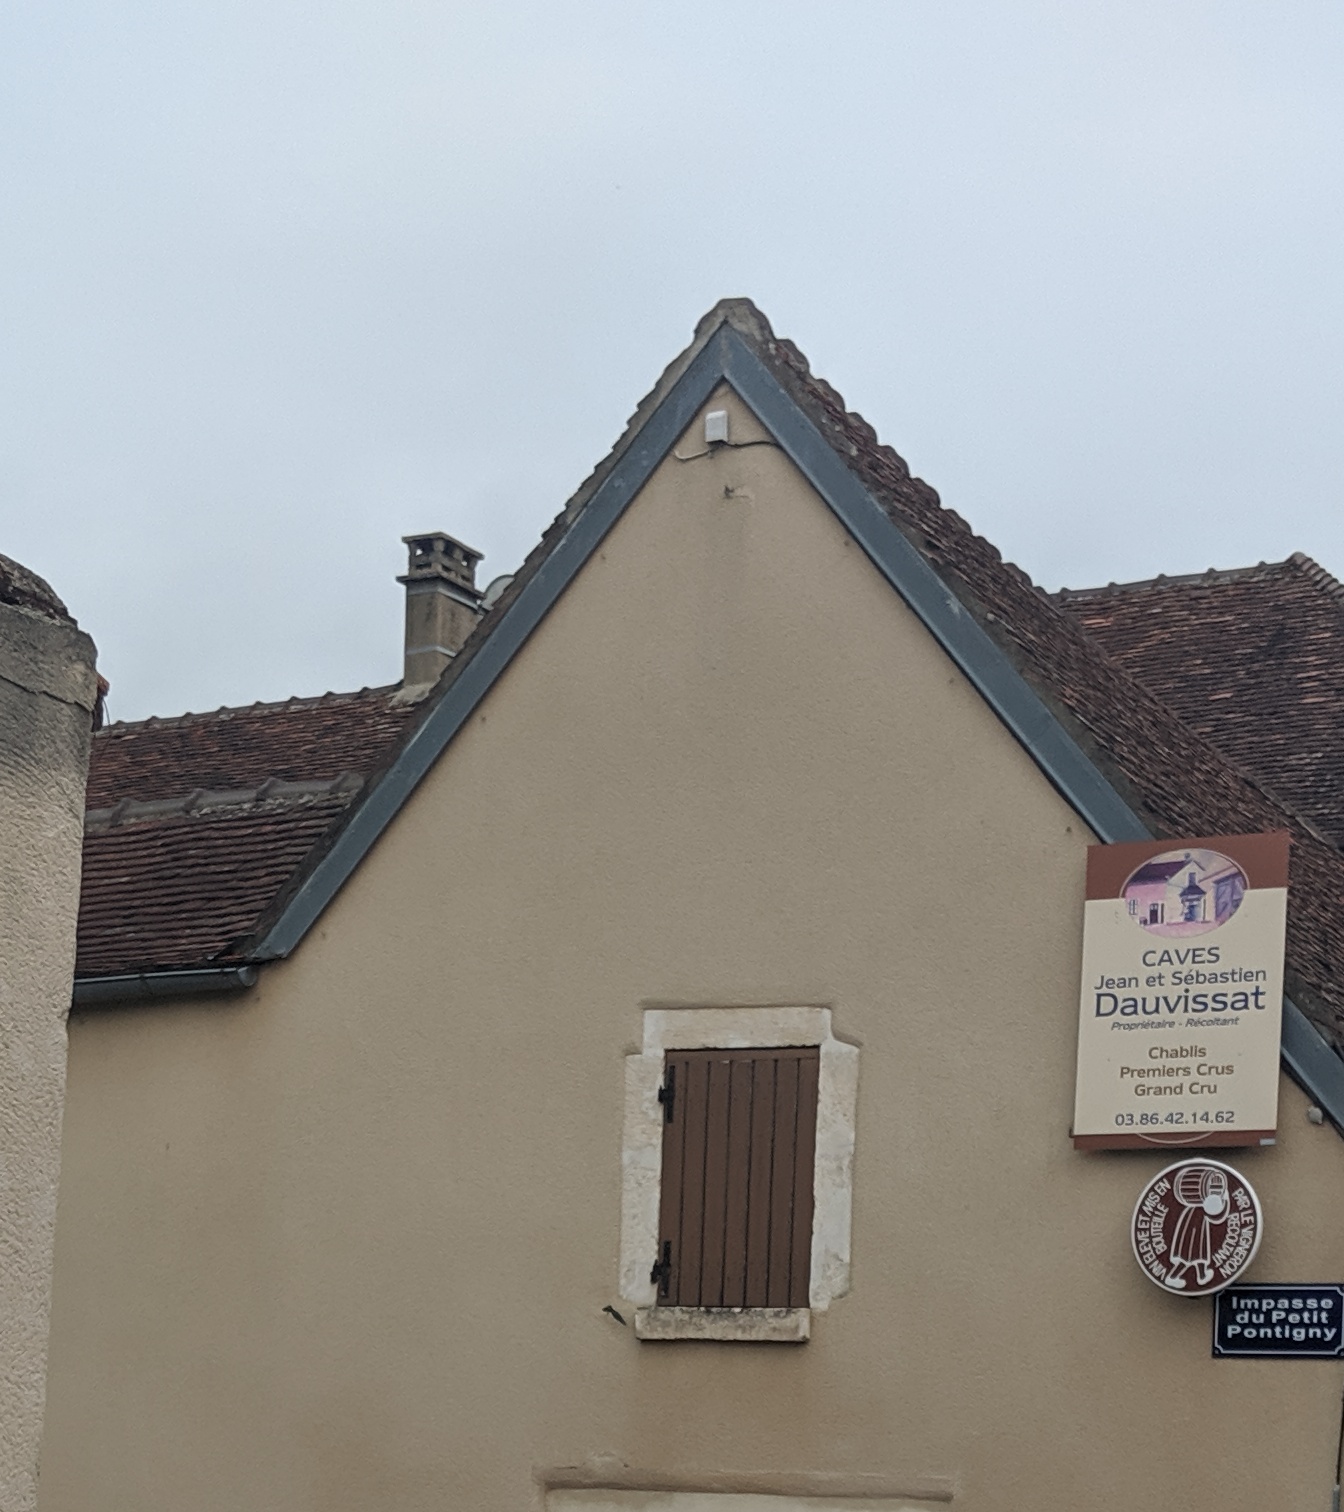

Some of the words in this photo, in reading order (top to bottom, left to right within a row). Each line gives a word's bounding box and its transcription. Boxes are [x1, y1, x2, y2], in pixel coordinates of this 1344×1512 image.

[1142, 947, 1220, 967] CAVES
[1094, 975, 1139, 990] Jean
[1146, 973, 1165, 987] et
[1171, 967, 1267, 986] Sébastien
[1095, 986, 1266, 1017] Dauvissat
[1111, 1019, 1175, 1032] Propriétaire
[1185, 1016, 1239, 1028] Récoltant
[1148, 1045, 1207, 1060] Chablis
[1120, 1064, 1191, 1078] Premiers
[1196, 1063, 1234, 1076] Crus
[1134, 1083, 1183, 1096] Grand
[1189, 1082, 1218, 1094] Cru
[1115, 1111, 1235, 1126] 03.86.42.14.62
[1154, 1178, 1171, 1196] EN
[1142, 1191, 1160, 1217] MIS
[1232, 1187, 1251, 1211] PAR
[1137, 1214, 1150, 1229] ET
[1240, 1209, 1255, 1224] LE
[1150, 1203, 1169, 1255] BOUTEILLE
[1219, 1224, 1255, 1279] VIGNERON
[1148, 1259, 1167, 1281] VIN
[1232, 1296, 1334, 1312] Impasse
[1236, 1311, 1265, 1324] du
[1271, 1310, 1328, 1324] Petit
[1227, 1325, 1337, 1342] Pontigny
